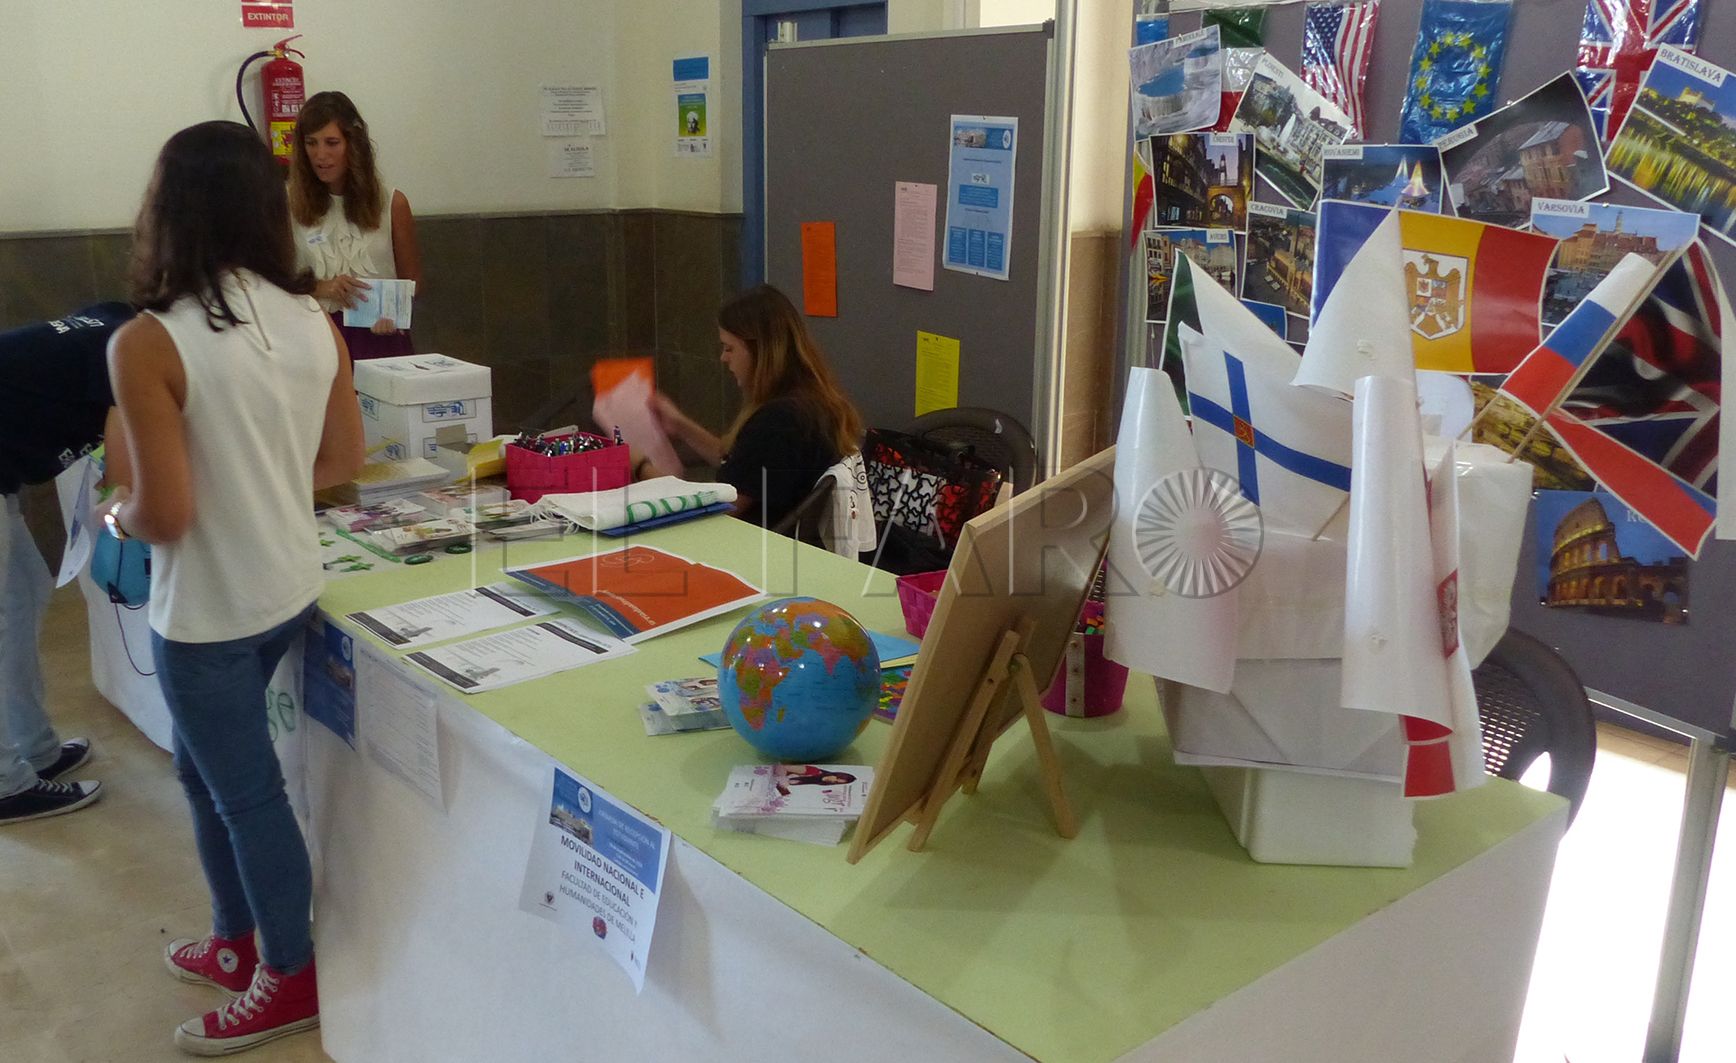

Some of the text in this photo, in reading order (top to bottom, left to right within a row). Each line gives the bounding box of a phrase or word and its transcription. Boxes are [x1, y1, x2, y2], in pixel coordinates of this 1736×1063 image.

[247, 12, 289, 21] EXTINTOR
[1659, 48, 1722, 83] BRATISLAVA
[1251, 203, 1285, 215] CRACOVIA
[1537, 201, 1585, 214] VARSOVIA
[560, 834, 602, 868] MOVILIDAD
[602, 861, 639, 895] NACIONAL
[638, 887, 645, 900] E
[573, 860, 631, 907] INTERNACIONAL
[561, 869, 592, 894] FACULTAD
[592, 887, 602, 901] DE
[559, 884, 607, 918] HUMANIDADES
[606, 912, 615, 925] DE
